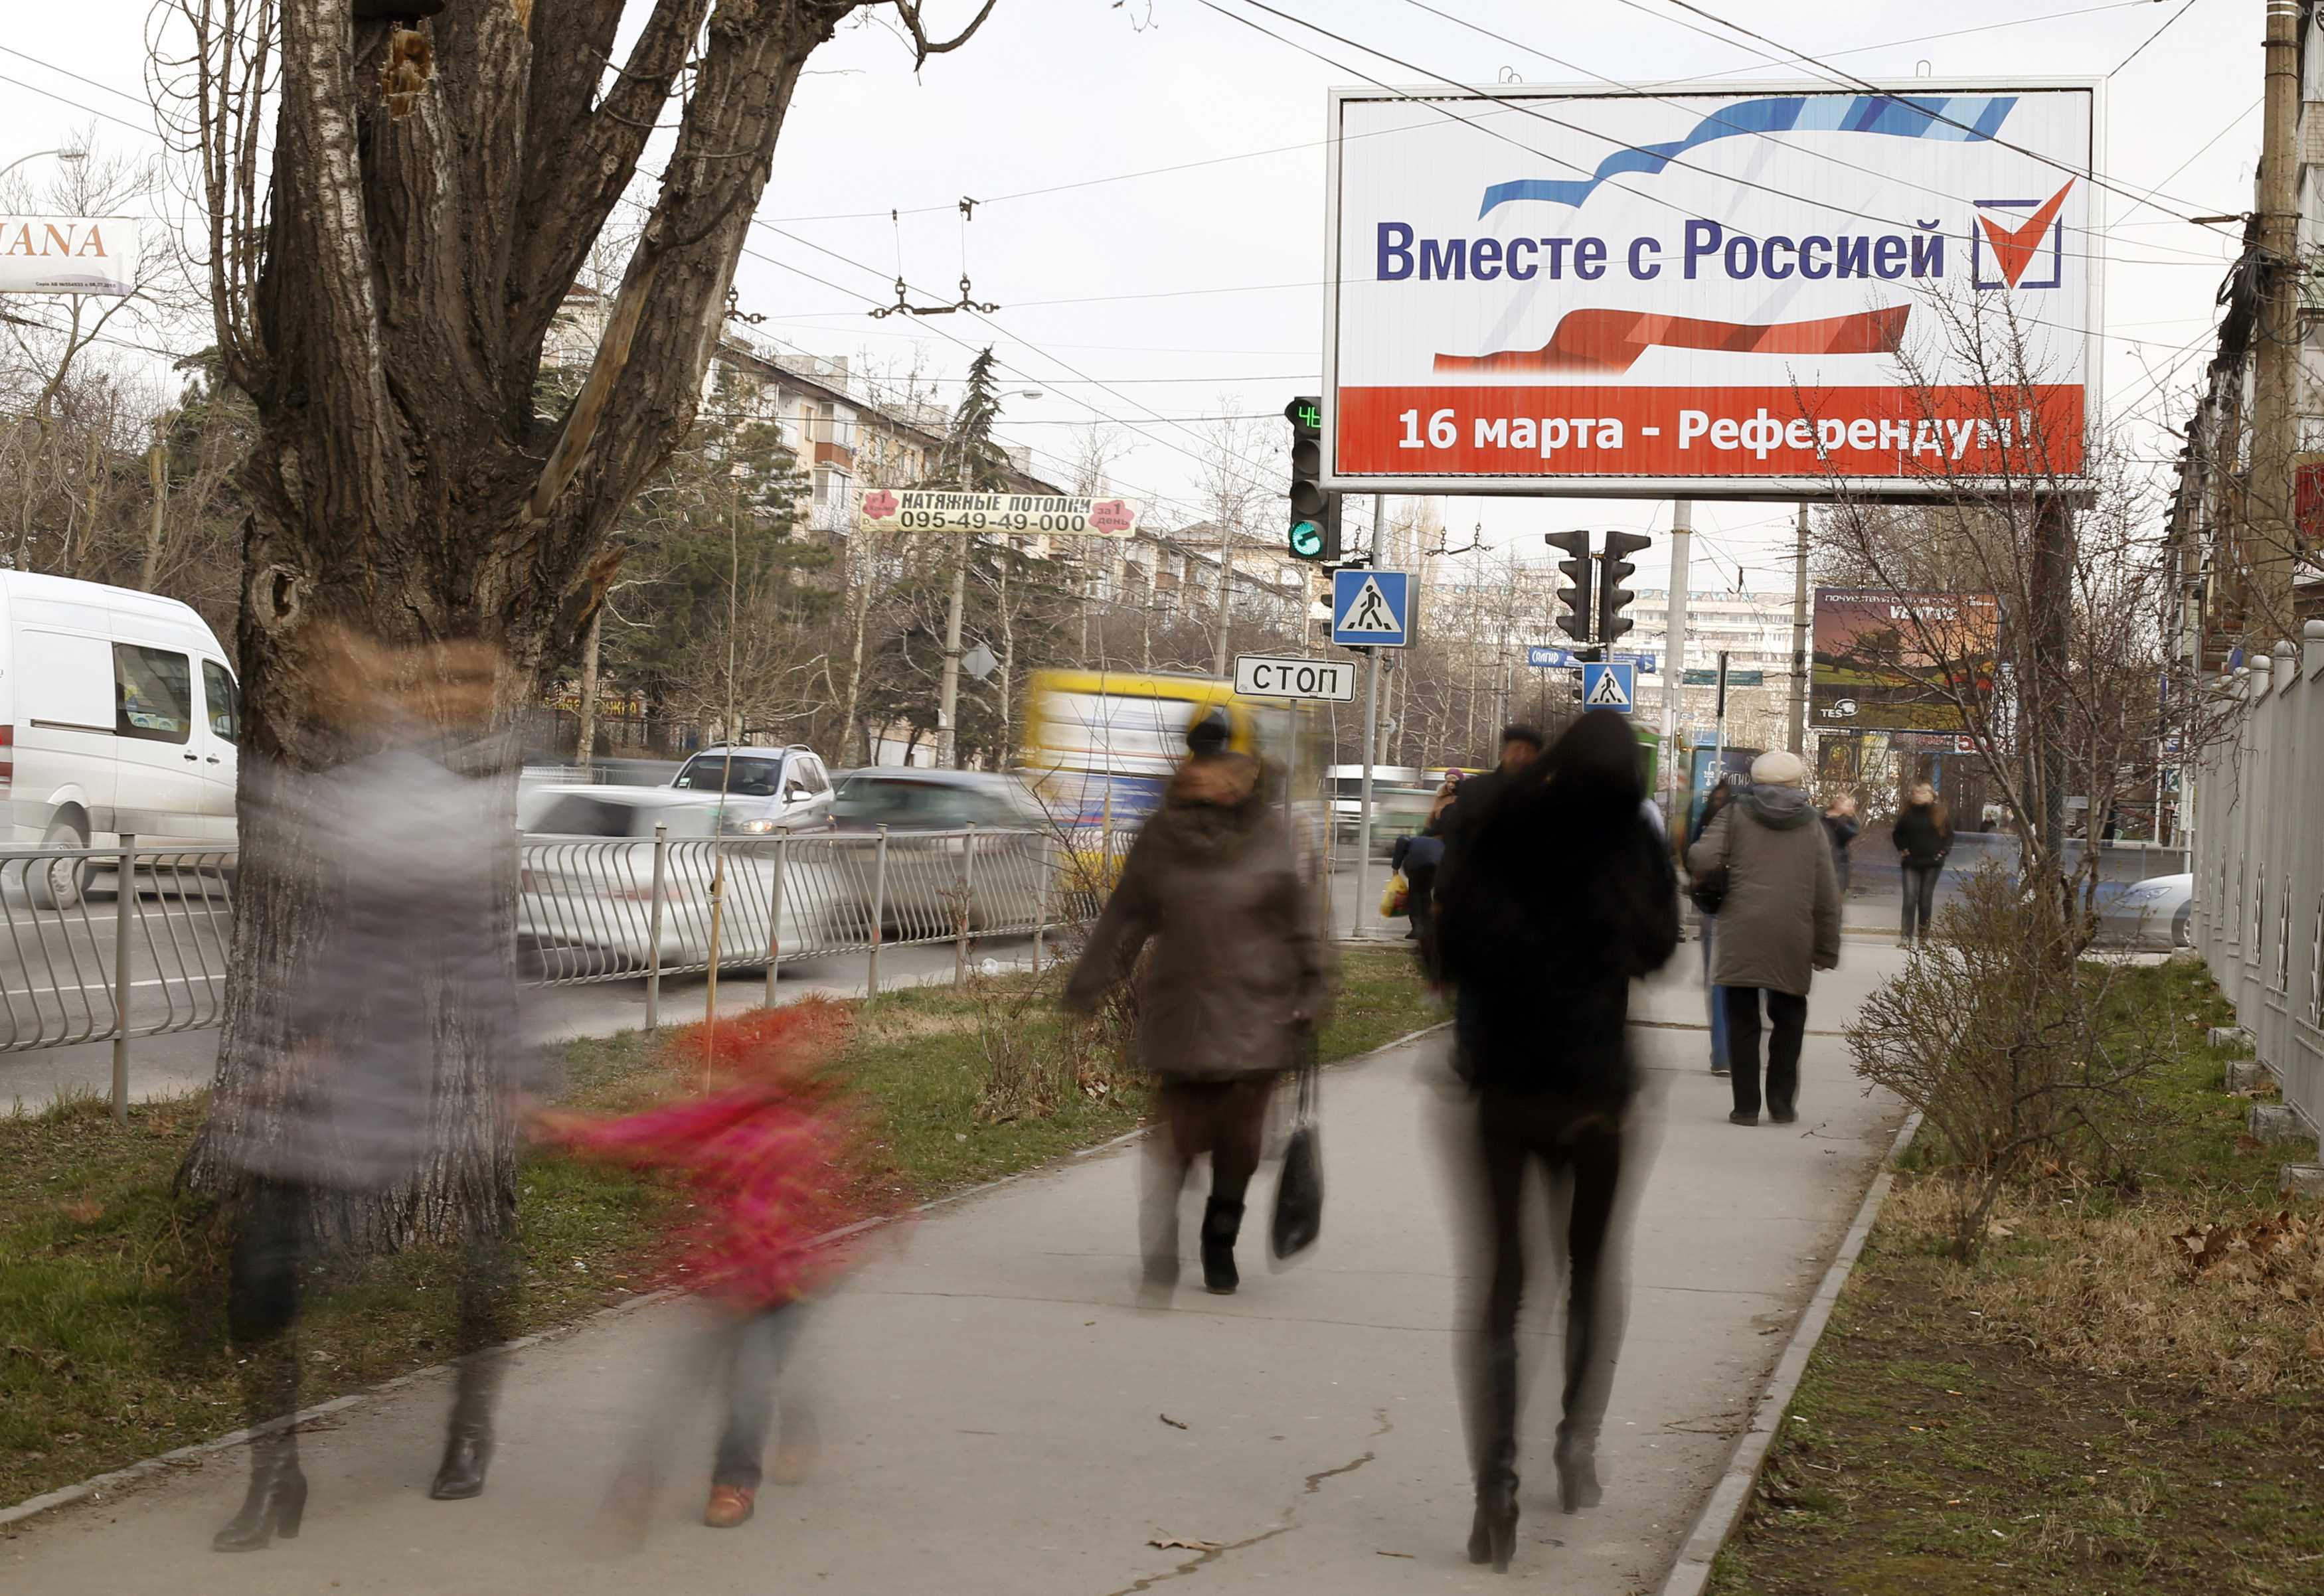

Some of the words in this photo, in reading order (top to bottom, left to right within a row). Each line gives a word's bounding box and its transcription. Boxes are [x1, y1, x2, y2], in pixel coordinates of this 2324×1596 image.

[1376, 222, 1607, 281] Вместе
[1627, 236, 1661, 280] с
[1683, 218, 1944, 279] Россией
[1398, 408, 1457, 449] 16
[1473, 416, 1623, 459] марта
[1641, 427, 1660, 436] -
[1678, 408, 2032, 460] Референдум!
[901, 493, 1001, 511] НАТЯЖНЫЕ
[1009, 497, 1092, 514] ПОТОЛКИ
[1114, 502, 1121, 515] 1
[901, 511, 1086, 532] 095-49-49-000
[1097, 517, 1127, 526] день
[1253, 664, 1337, 693] СТОП
[1820, 708, 1843, 718] TES
